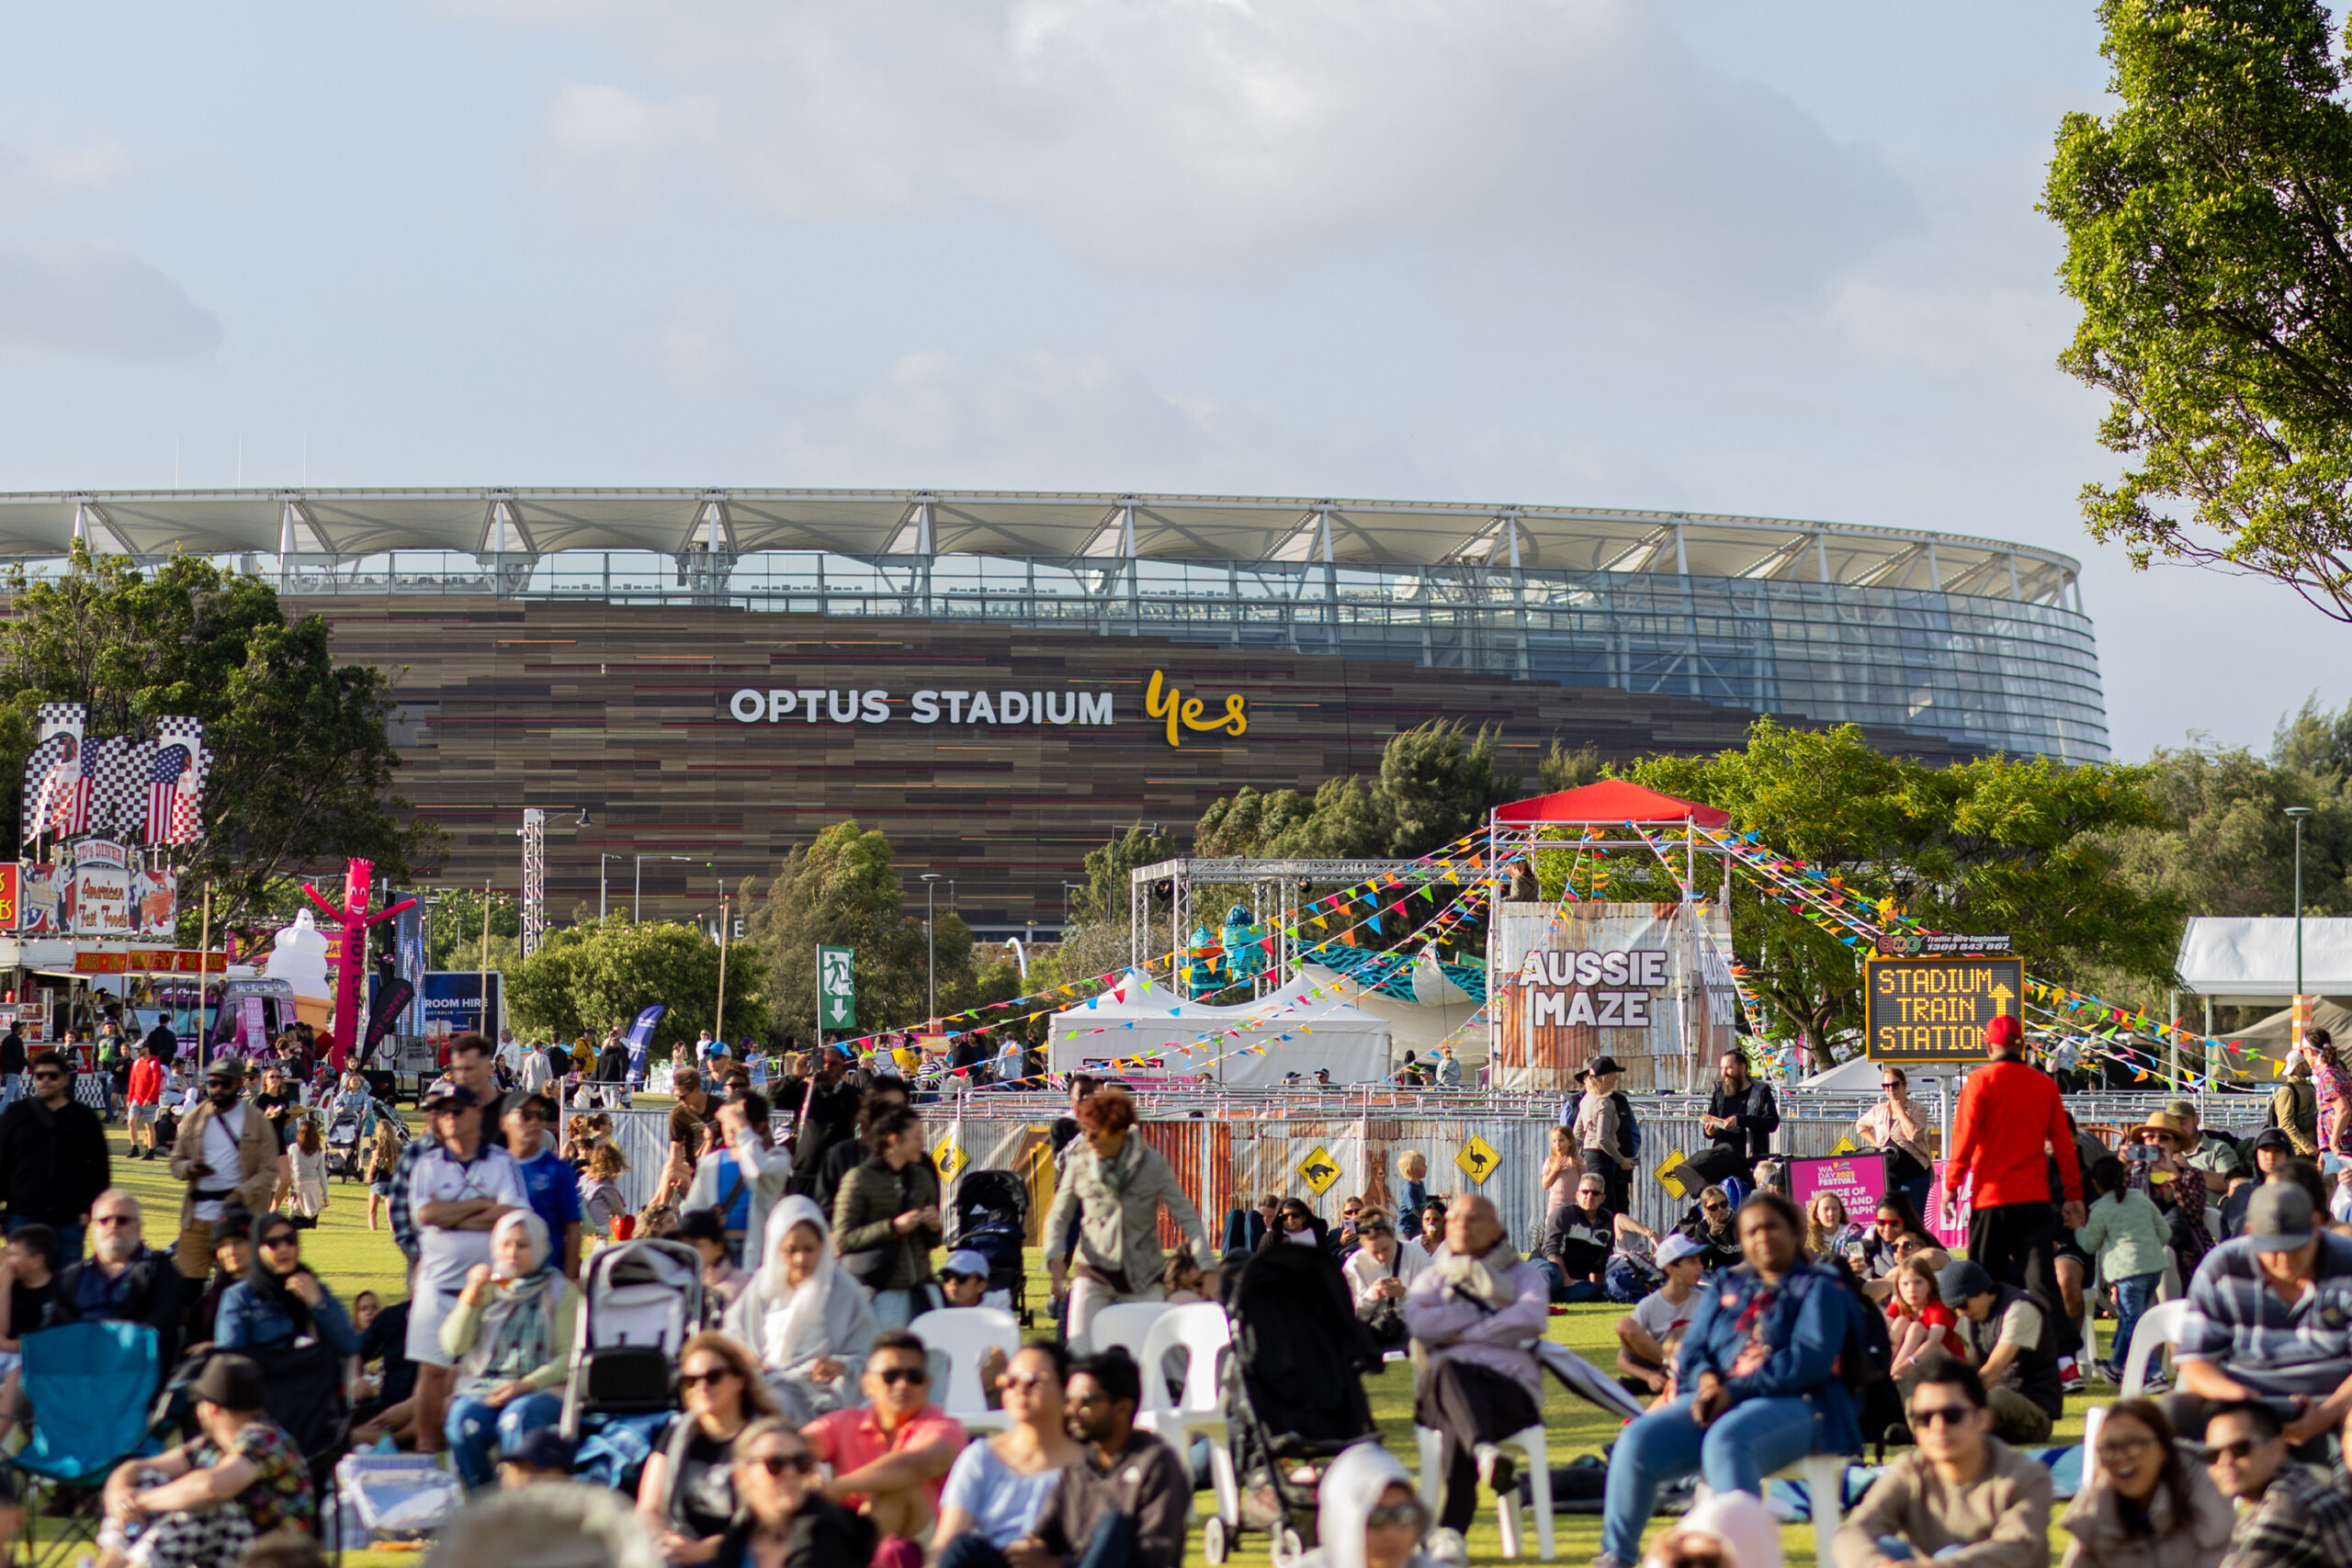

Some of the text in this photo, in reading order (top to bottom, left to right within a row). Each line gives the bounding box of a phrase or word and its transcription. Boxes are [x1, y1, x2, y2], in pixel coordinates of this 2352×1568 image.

[729, 689, 1114, 725] OPTUS STADIUM
[95, 842, 123, 863] DINER
[82, 876, 125, 902] American
[78, 904, 128, 929] Fast Foods
[734, 920, 744, 937] E
[351, 928, 364, 965] HOT
[1927, 942, 1957, 951] 1300
[1959, 942, 1984, 951] 843
[1519, 951, 1668, 987] AUSSIE
[1878, 968, 1992, 993] STADIUM
[382, 986, 409, 1022] COFFEE
[462, 998, 489, 1008] HIRE
[1534, 991, 1650, 1027] MAZE
[1896, 997, 1975, 1021] TRAIN
[1818, 1177, 1857, 1186] FESTIVAL
[1851, 1187, 1866, 1195] OF
[1850, 1196, 1873, 1204] AND
